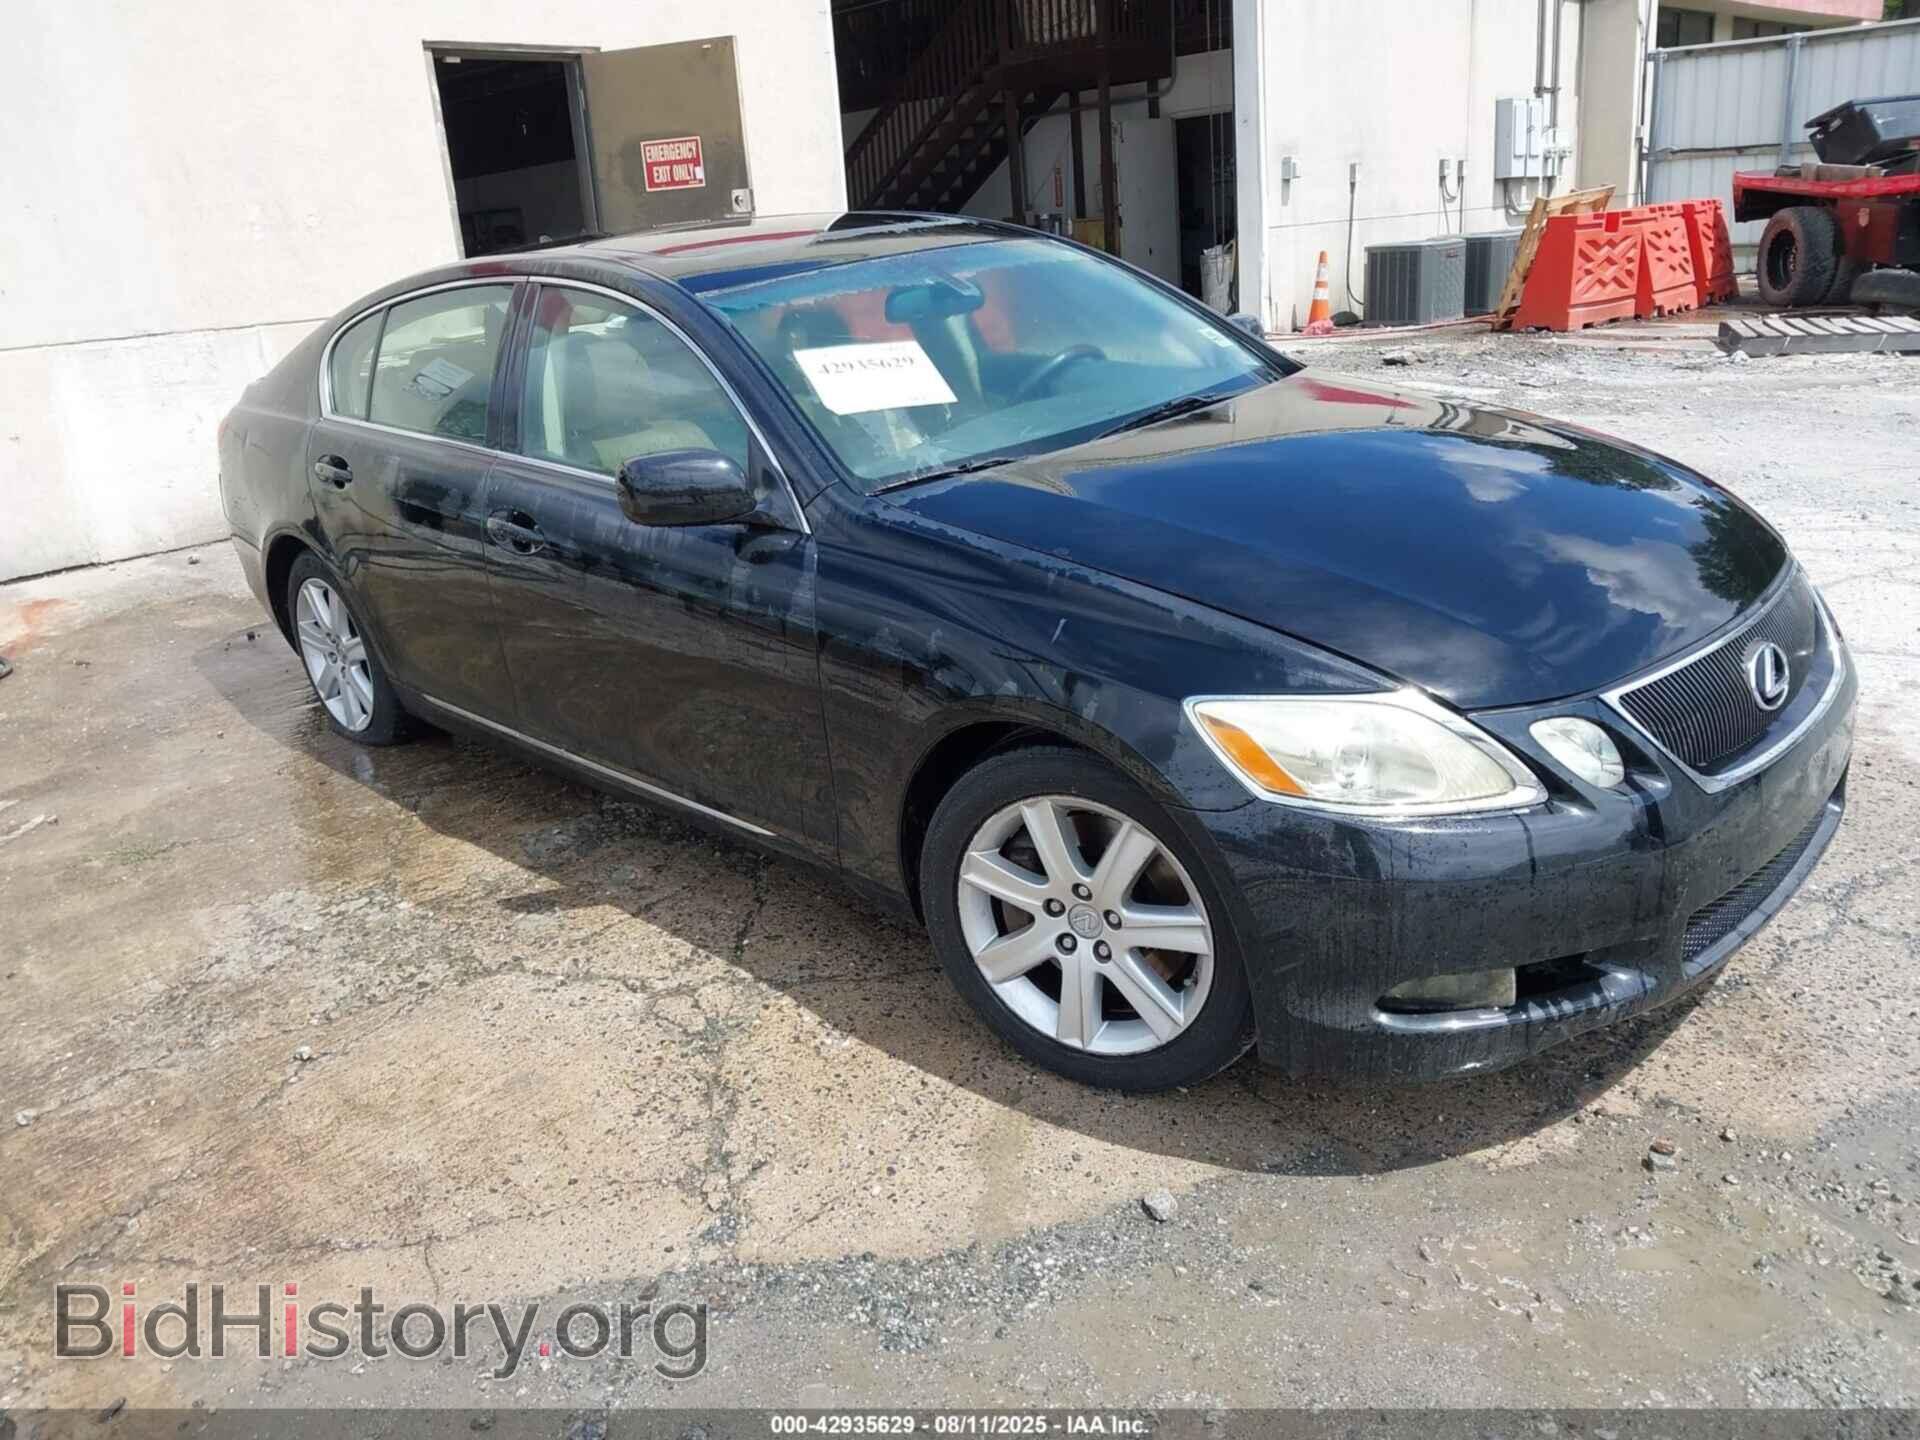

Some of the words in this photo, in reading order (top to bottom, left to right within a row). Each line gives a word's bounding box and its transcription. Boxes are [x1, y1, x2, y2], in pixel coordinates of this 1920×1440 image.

[645, 141, 698, 162] EMERGENCY
[653, 165, 672, 183] EXIT
[672, 163, 695, 182] ONLY
